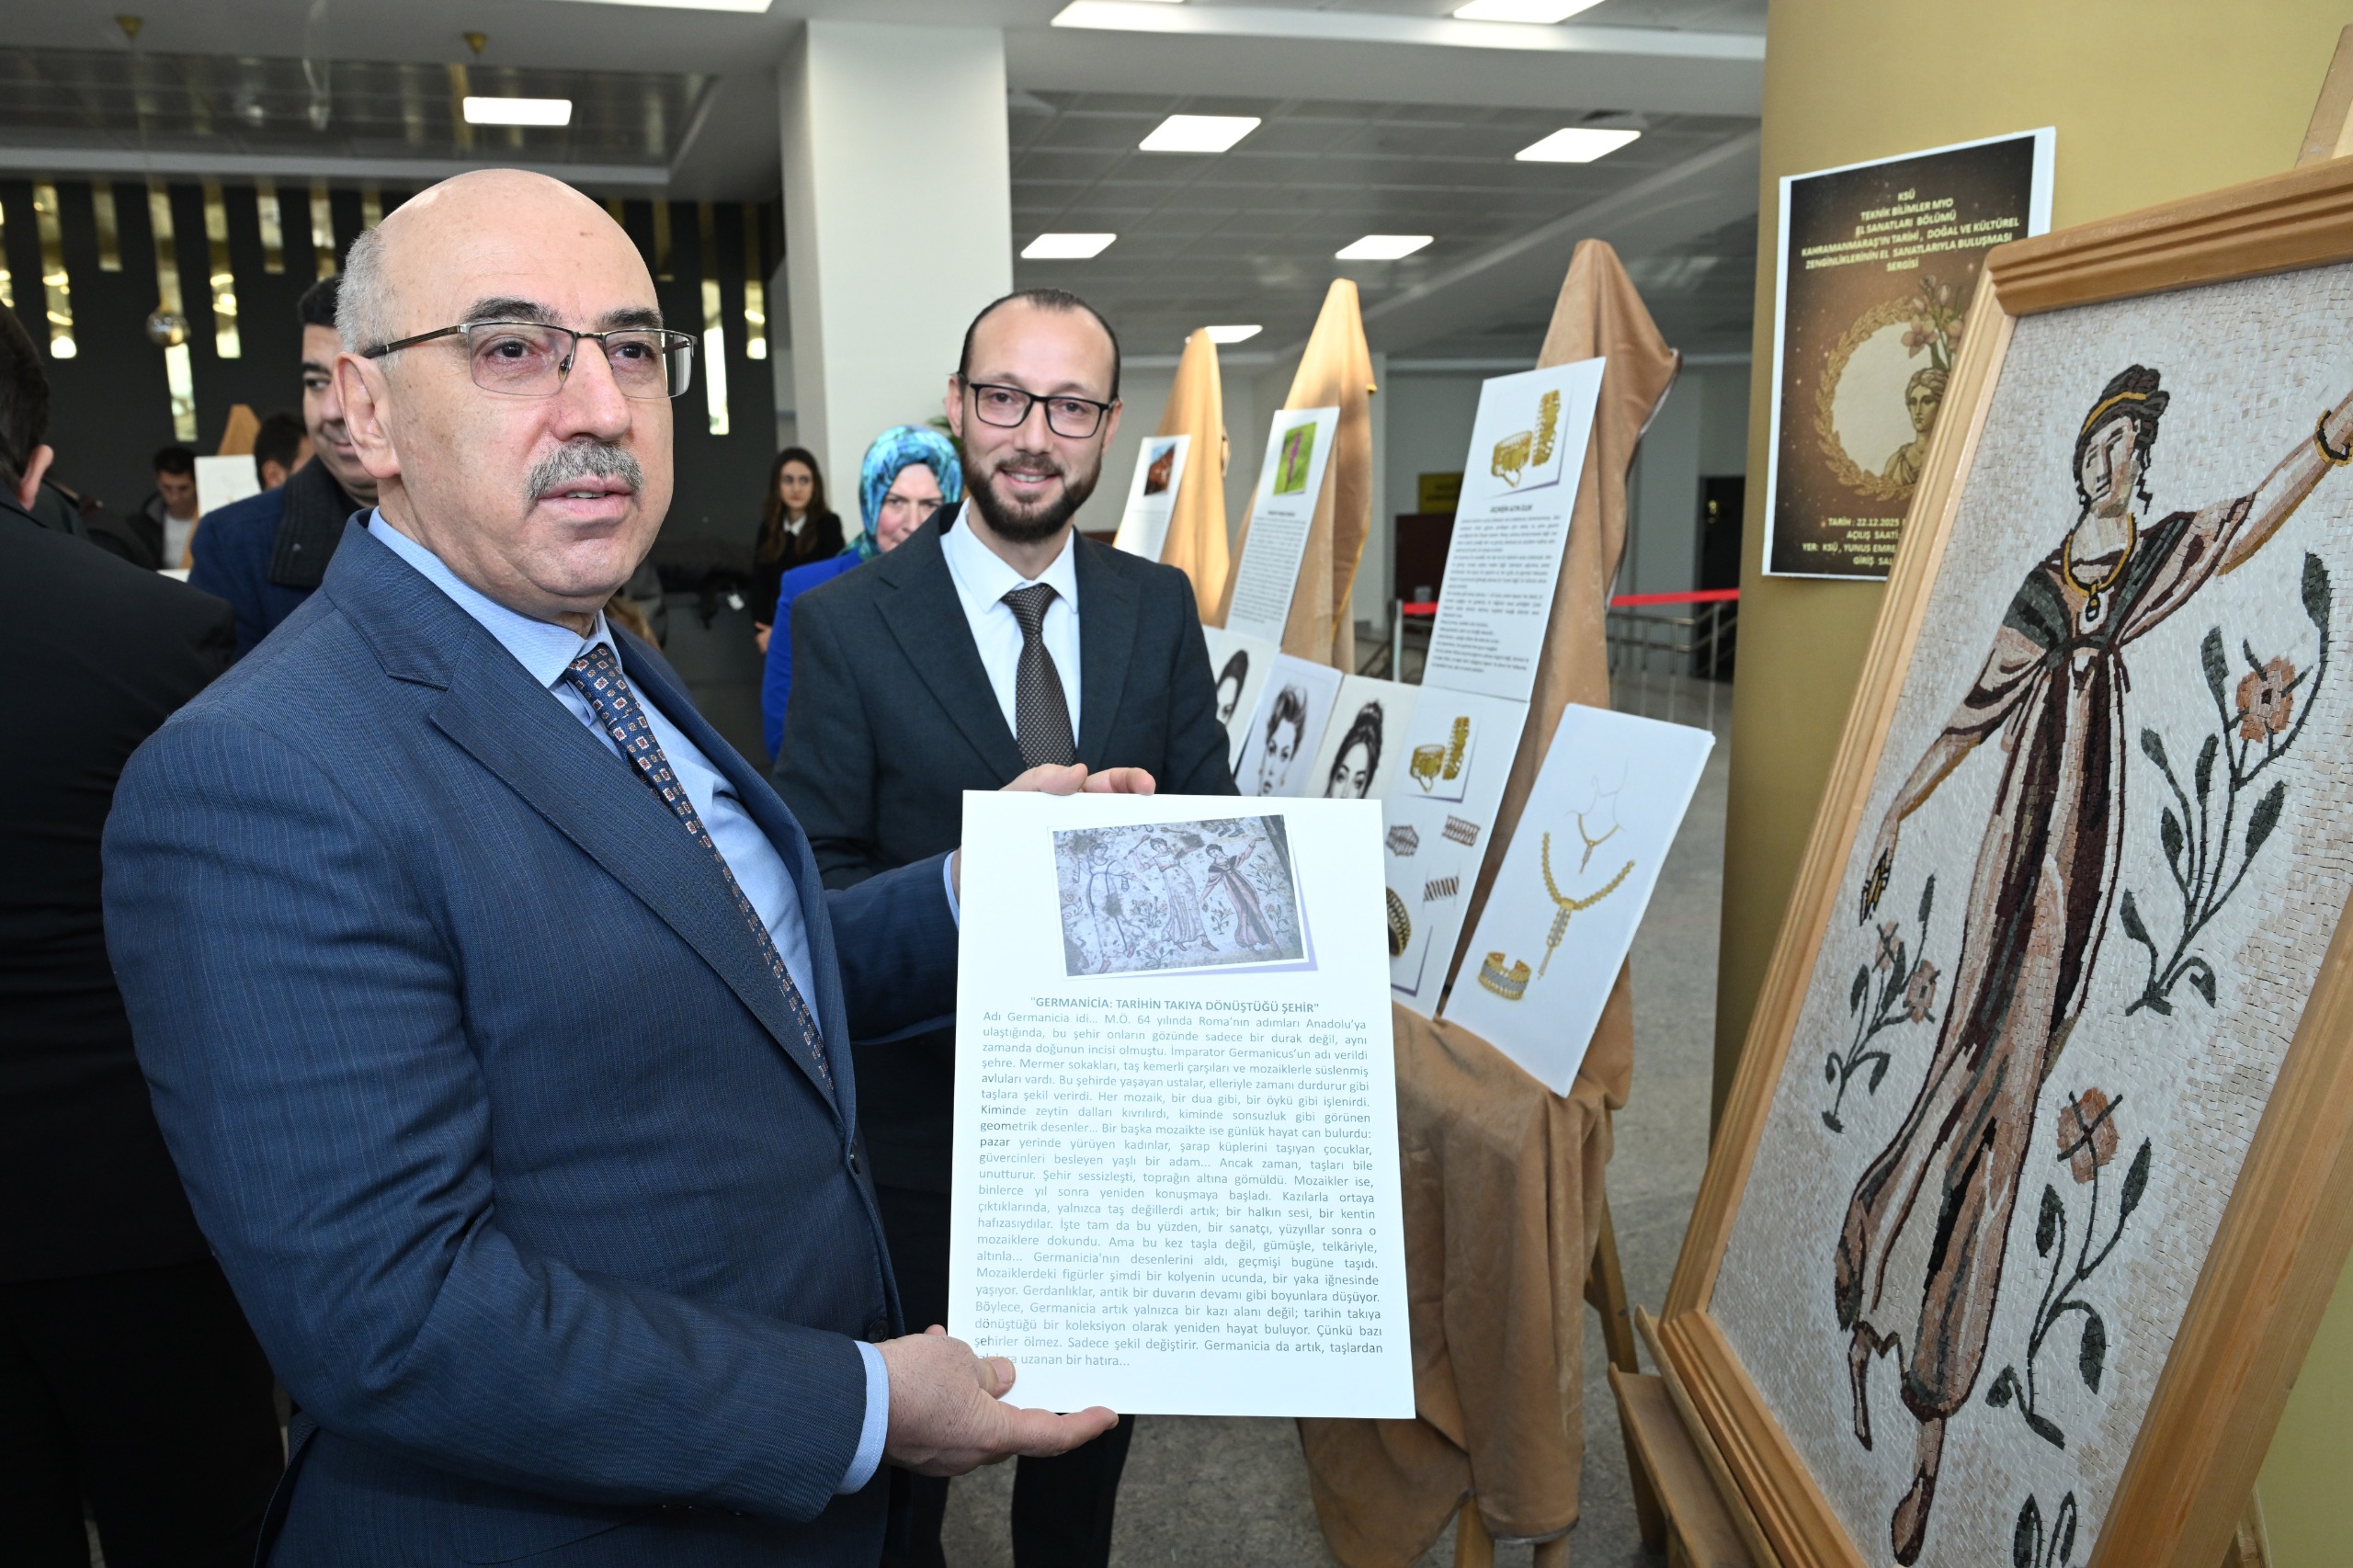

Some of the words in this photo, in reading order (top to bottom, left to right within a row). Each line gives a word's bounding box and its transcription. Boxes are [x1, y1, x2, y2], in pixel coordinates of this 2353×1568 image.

[1898, 187, 1916, 201] KSÜ
[1860, 208, 1891, 222] TEKNİK
[1892, 201, 1930, 217] BİLİMLER
[1932, 198, 1954, 210] MYO
[1855, 224, 1868, 236] EL
[1868, 218, 1913, 233] SANATLARI
[1916, 210, 1957, 227] BÖLÜMÜ
[1927, 224, 1960, 240] DOĞAL
[1961, 222, 1972, 234] VE
[1972, 217, 2019, 233] KÜLTÜREL
[1880, 248, 1889, 259] EL
[1893, 240, 1957, 258] SANATLARIYLA
[1958, 232, 2012, 250] BULUŞMASI
[1886, 258, 1919, 272] SERGİSİ
[1846, 530, 1871, 541] AÇILIŞ
[1843, 543, 1871, 553] YUNUS
[1852, 555, 1875, 567] GİRİŞ
[1115, 997, 1162, 1010] TARİHİN
[1164, 1000, 1203, 1011] TAKIYA
[1205, 999, 1279, 1014] DÖNÜŞTÜĞÜ
[983, 1010, 1001, 1021] Adı
[1006, 1011, 1070, 1023] Germanicia
[1104, 1012, 1131, 1025] M.Ö.
[1137, 1015, 1151, 1025] 64
[1156, 1015, 1193, 1028] yılında
[1256, 1017, 1300, 1028] adımları
[983, 1026, 1046, 1040] ulaştığında,
[1052, 1028, 1067, 1039] bu
[1073, 1028, 1101, 1041] şehir
[1107, 1029, 1145, 1040] onların
[1152, 1030, 1199, 1042] gözünde
[1205, 1031, 1244, 1042] sadece
[1249, 1032, 1265, 1042] bir
[1271, 1032, 1302, 1043] durak
[1308, 1033, 1338, 1047] değil,
[1345, 1037, 1368, 1047] aynı
[982, 1042, 1032, 1053] zamanda
[1035, 1042, 1085, 1056] doğunun
[1087, 1044, 1116, 1055] incisi
[1119, 1045, 1167, 1058] olmuştu.
[1171, 1044, 1226, 1059] İmparator
[1314, 1049, 1331, 1060] adı
[1334, 1050, 1368, 1061] verildi
[982, 1057, 1016, 1070] şehre.
[1019, 1058, 1065, 1069] Mermer
[1068, 1059, 1120, 1073] sokakları,
[1122, 1061, 1140, 1074] taş
[1143, 1061, 1184, 1072] kemerli
[1187, 1062, 1230, 1074] çarşıları
[1233, 1065, 1246, 1074] ve
[1249, 1063, 1313, 1074] mozaiklerle
[1314, 1064, 1369, 1078] süslenmiş
[981, 1104, 1027, 1116] Kiminde
[1035, 1106, 1069, 1119] zeytin
[1077, 1106, 1112, 1118] dalları
[1121, 1107, 1170, 1121] kıvrılırdı,
[1178, 1108, 1223, 1120] kiminde
[1232, 1110, 1287, 1121] sonsuzluk
[1295, 1111, 1315, 1124] gibi
[1324, 1112, 1370, 1125] görünen
[980, 1138, 1011, 1149] pazar
[1018, 1137, 1062, 1150] yerinde
[1070, 1138, 1116, 1152] yürüyen
[1124, 1139, 1171, 1153] kadınlar,
[1179, 1142, 1211, 1153] şarap
[1219, 1141, 1267, 1154] küplerini
[1276, 1143, 1315, 1155] taşıyan
[1324, 1143, 1372, 1156] çocuklar,
[979, 1153, 1045, 1165] güvercinleri
[1053, 1153, 1104, 1167] besleyen
[1111, 1154, 1136, 1168] yaşlı
[1145, 1155, 1161, 1166] bir
[1219, 1157, 1254, 1168] Ancak
[1261, 1160, 1302, 1171] zaman,
[1309, 1159, 1344, 1173] taşları
[1352, 1160, 1373, 1171] bile
[979, 1169, 1036, 1180] unutturur.
[1042, 1169, 1072, 1183] Şehir
[1077, 1170, 1136, 1184] sessizleşti,
[1142, 1172, 1190, 1186] toprağın
[1196, 1172, 1228, 1184] altına
[1234, 1174, 1288, 1187] gömüldü.
[1294, 1175, 1349, 1187] Mozaikler
[1355, 1176, 1374, 1188] ise,
[977, 1233, 1040, 1245] mozaiklere
[1047, 1234, 1101, 1247] dokundu.
[1108, 1236, 1135, 1247] Ama
[1142, 1236, 1157, 1248] bu
[1165, 1237, 1184, 1249] kez
[1190, 1238, 1218, 1252] taşla
[1224, 1238, 1256, 1252] değil,
[1263, 1240, 1314, 1254] gümüşle,
[1322, 1240, 1378, 1255] telkâriyle,
[1130, 1253, 1194, 1266] desenlerini
[1203, 1255, 1228, 1268] aldı,
[1238, 1256, 1280, 1269] geçmişi
[1290, 1256, 1335, 1270] bugüne
[1344, 1257, 1378, 1271] taşıdı.
[975, 1286, 1018, 1298] yaşıyor.
[1022, 1284, 1096, 1299] Gerdanlıklar,
[1099, 1286, 1129, 1298] antik
[1132, 1286, 1149, 1298] bir
[1152, 1287, 1196, 1299] duvarın
[1199, 1288, 1242, 1300] devamı
[1245, 1289, 1267, 1302] gibi
[1270, 1289, 1328, 1303] boyunlara
[1332, 1290, 1380, 1304] düşüyor.
[974, 1317, 1037, 1333] dönüştüğü
[1043, 1318, 1060, 1331] bir
[1065, 1319, 1126, 1335] koleksiyon
[1131, 1320, 1168, 1333] olarak
[1174, 1322, 1221, 1335] yeniden
[1226, 1322, 1258, 1336] hayat
[1264, 1323, 1311, 1337] buluyor.
[1316, 1324, 1353, 1338] Çünkü
[1358, 1324, 1382, 1336] bazı
[974, 1335, 1019, 1348] şehirler
[1023, 1335, 1063, 1347] ölmez.
[1067, 1336, 1109, 1348] Sadece
[1114, 1337, 1141, 1351] şekil
[1145, 1337, 1199, 1352] değiştirir.
[1204, 1339, 1270, 1352] Germanicia
[1275, 1340, 1290, 1352] da
[1294, 1341, 1324, 1355] artık,
[1329, 1341, 1383, 1356] taşlardan
[1020, 1356, 1063, 1365] uzanan
[1065, 1353, 1083, 1366] bir
